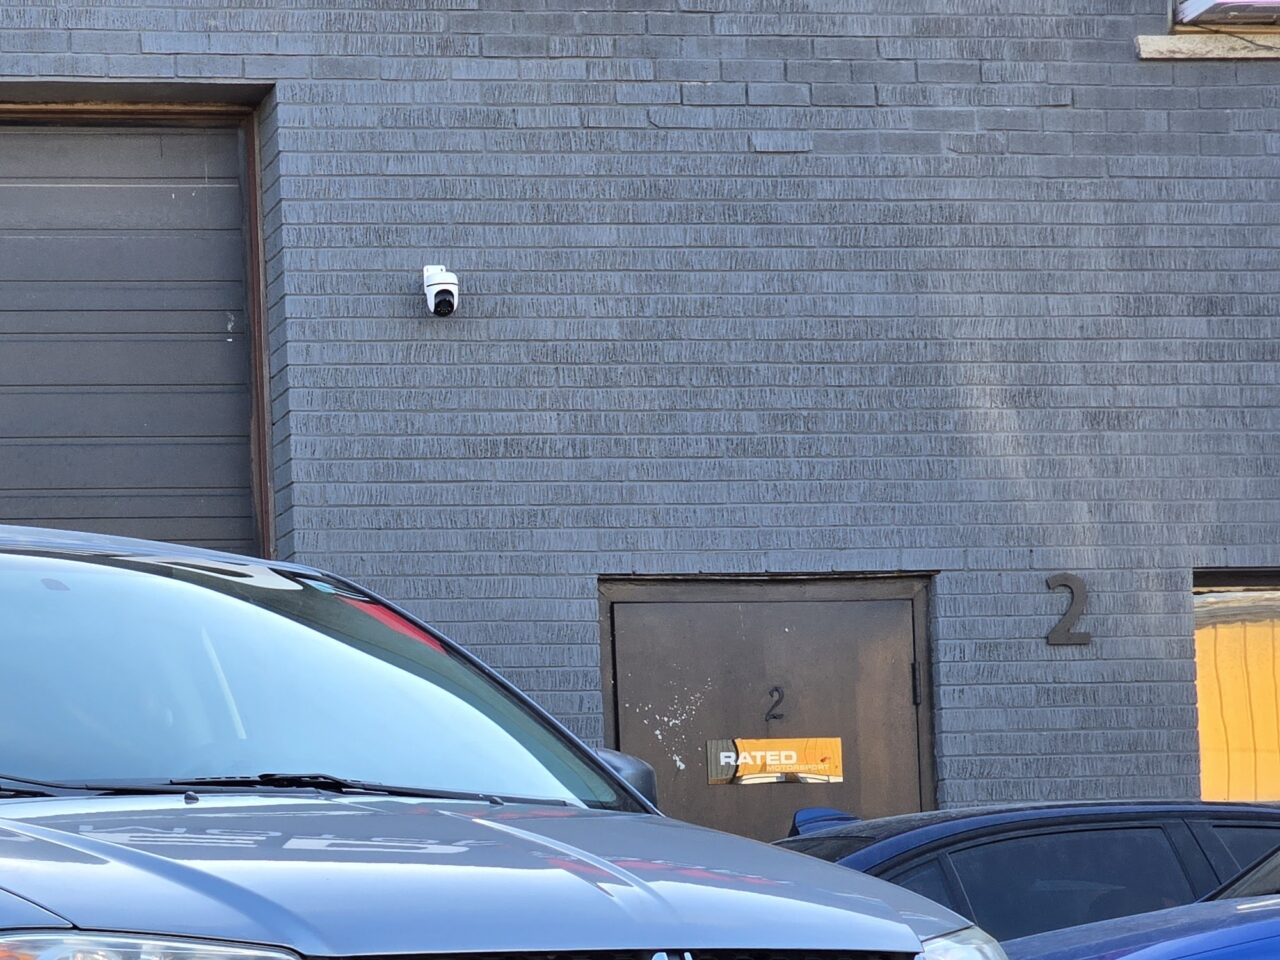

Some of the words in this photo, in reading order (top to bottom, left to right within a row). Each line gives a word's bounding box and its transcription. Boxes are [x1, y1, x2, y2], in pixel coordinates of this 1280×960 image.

[1046, 572, 1091, 646] 2
[764, 686, 785, 722] 2
[720, 750, 797, 766] RATED
[766, 763, 830, 771] MOTORSPORT
